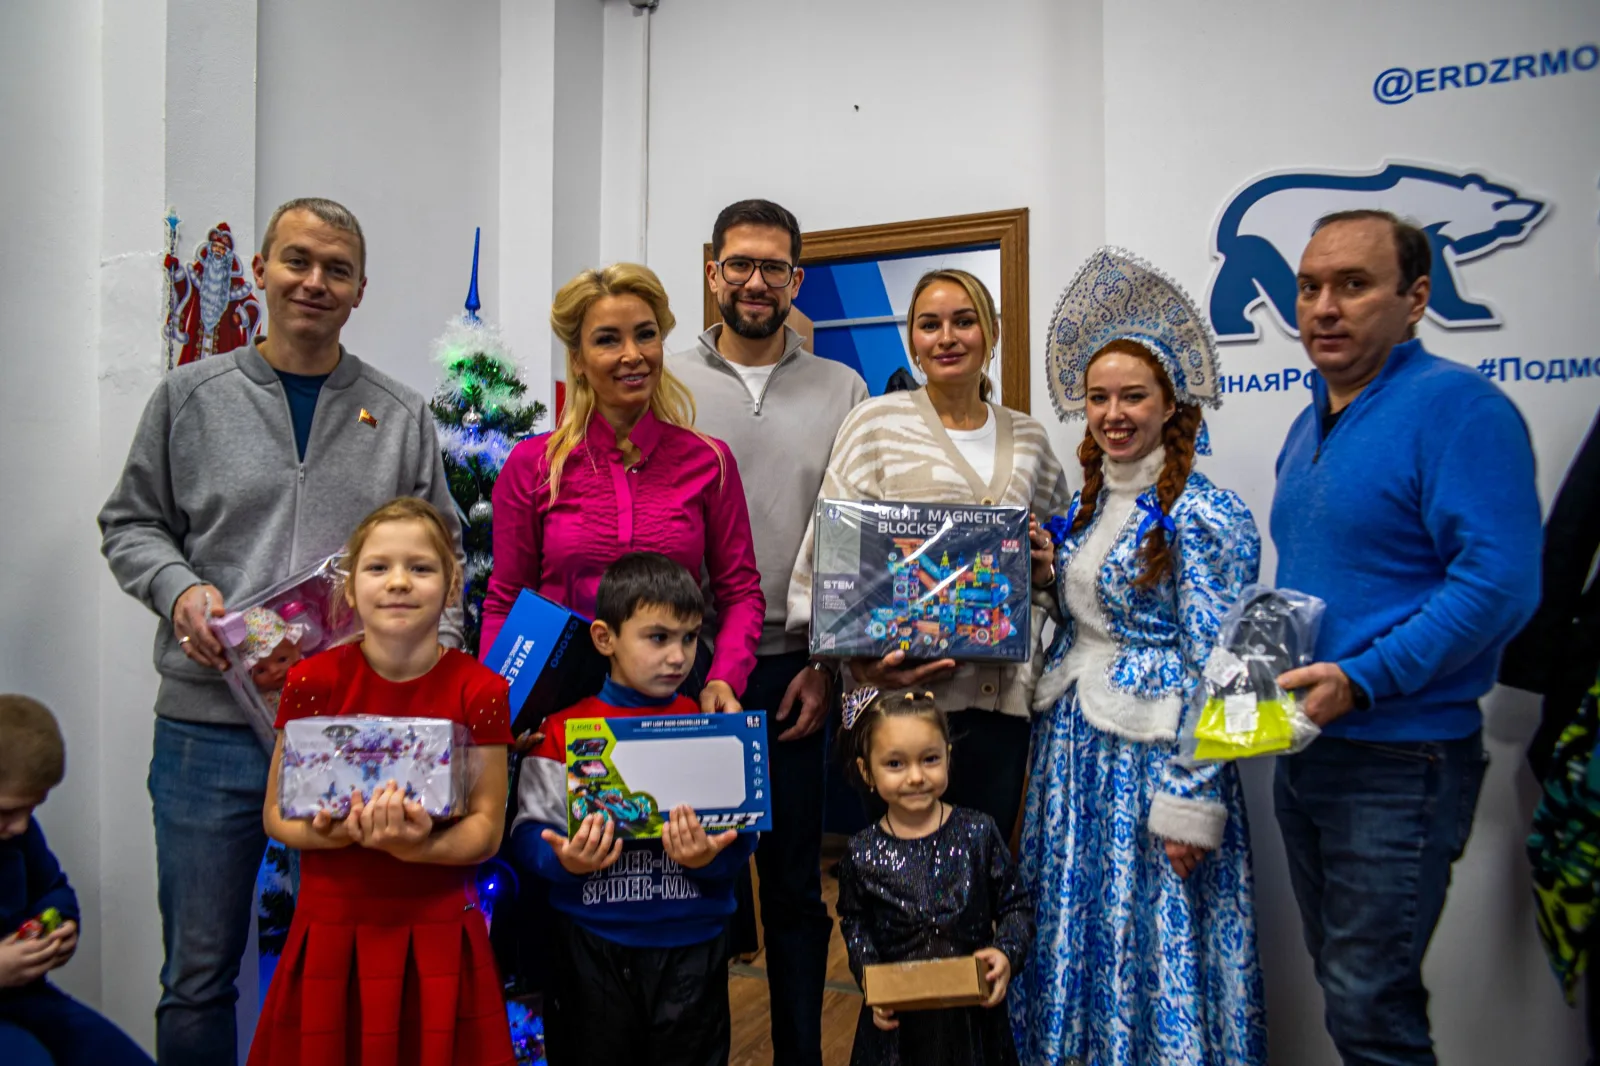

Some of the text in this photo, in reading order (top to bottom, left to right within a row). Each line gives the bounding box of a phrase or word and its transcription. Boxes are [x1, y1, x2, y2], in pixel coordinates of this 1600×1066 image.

[1373, 44, 1600, 105] @ERDZRMO
[877, 521, 937, 535] BLOCKS
[928, 509, 1006, 525] MAGNETIC
[823, 580, 855, 590] STEM
[505, 640, 535, 687] WIRED
[582, 874, 702, 905] SPIDER-MA
